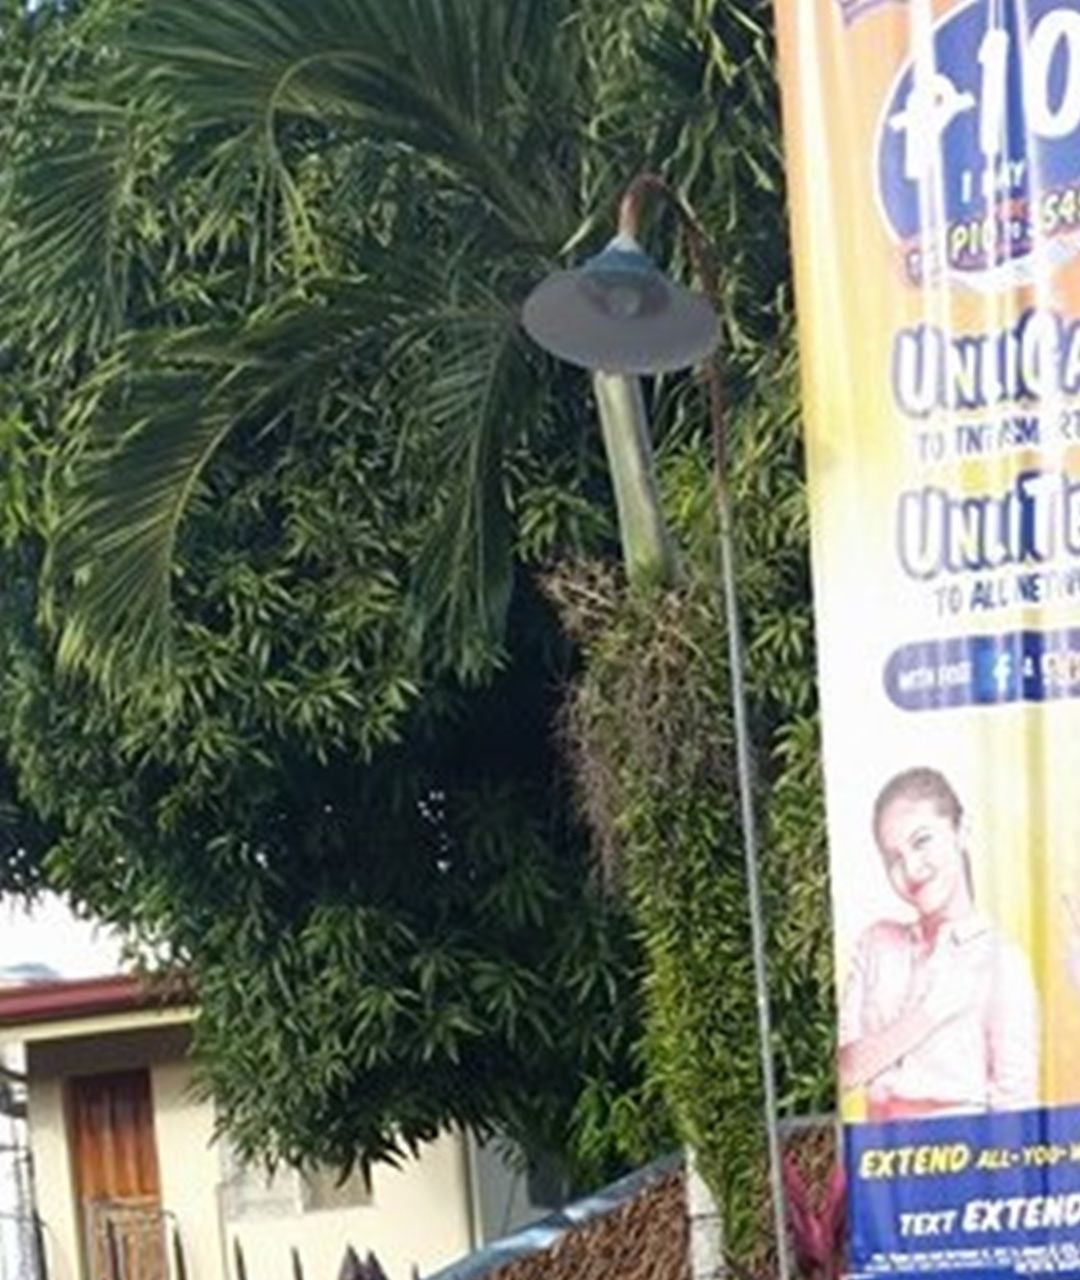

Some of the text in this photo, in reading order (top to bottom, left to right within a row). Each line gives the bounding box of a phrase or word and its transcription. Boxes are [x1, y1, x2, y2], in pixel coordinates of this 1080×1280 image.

[919, 433, 945, 461] TO
[935, 584, 963, 615] TO
[970, 576, 1008, 610] ALL
[859, 1142, 970, 1179] EXTEND
[899, 1209, 957, 1237] TEXT
